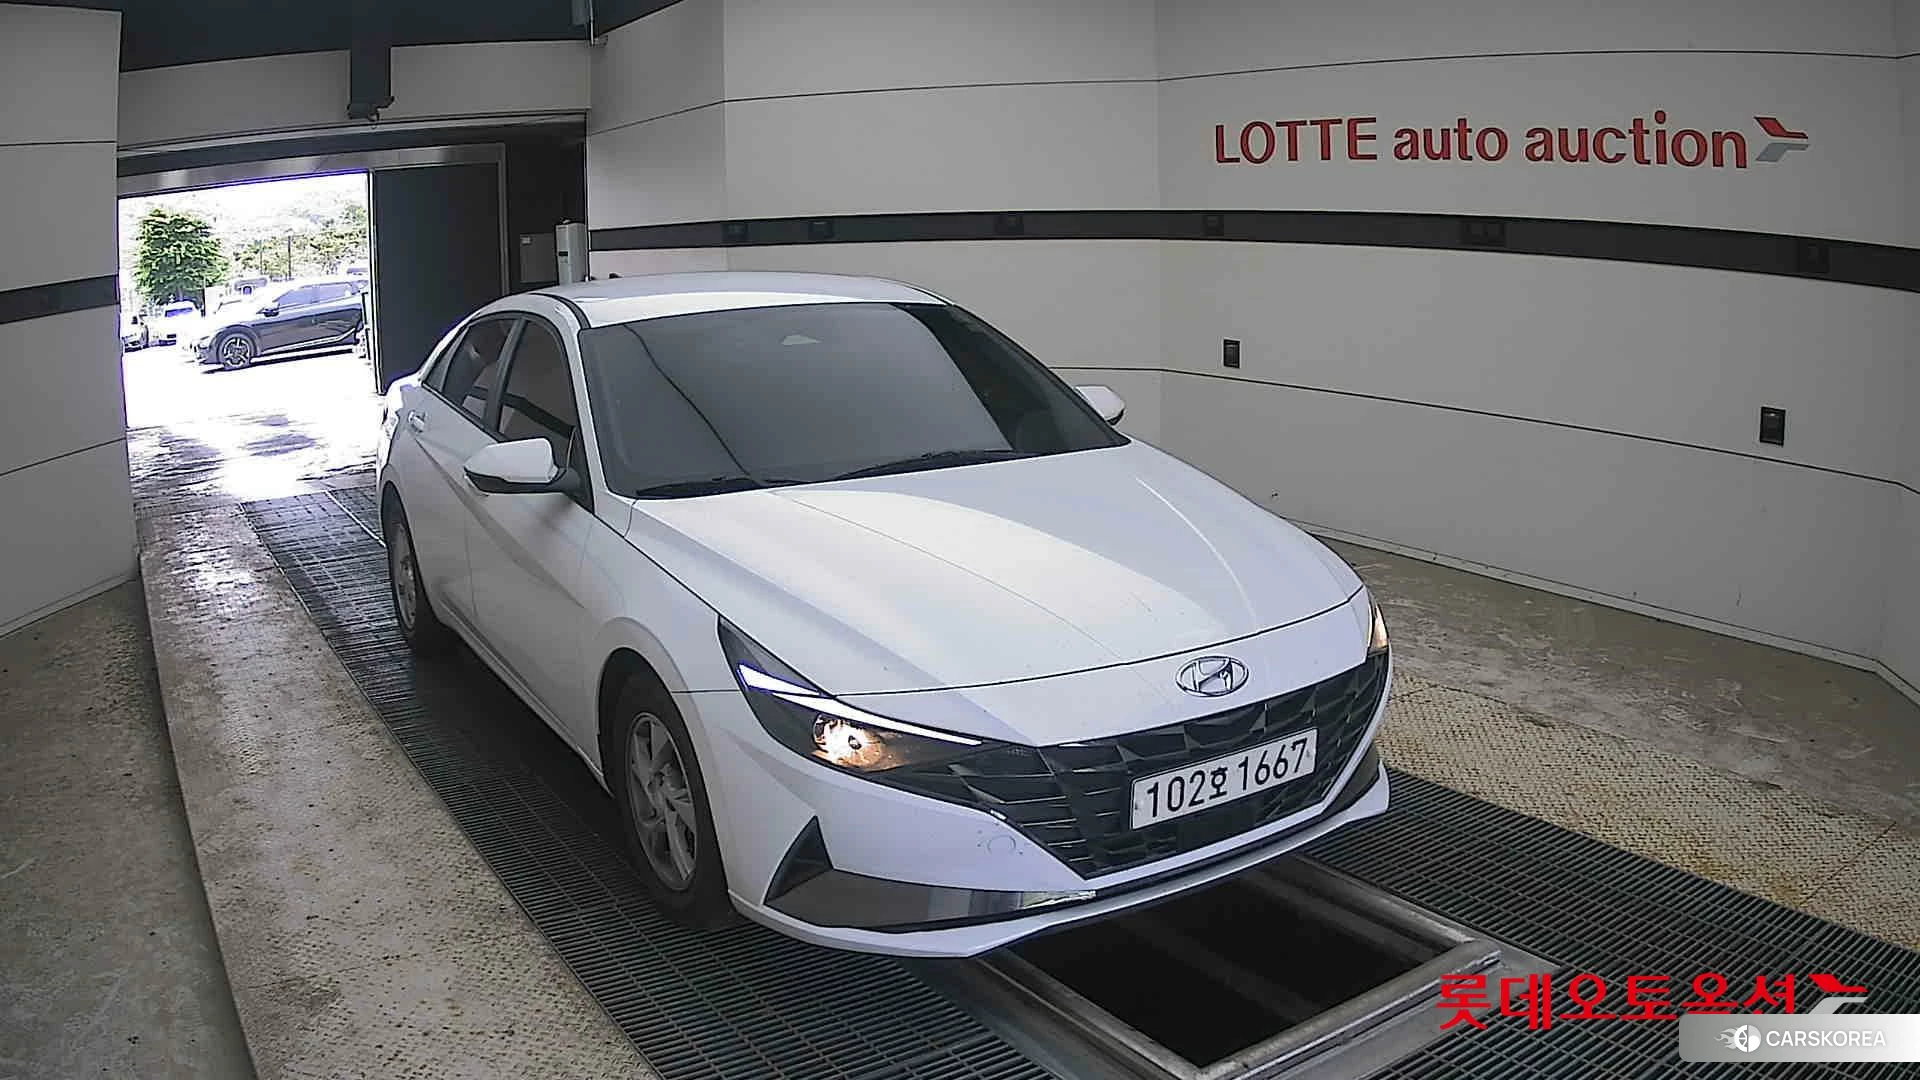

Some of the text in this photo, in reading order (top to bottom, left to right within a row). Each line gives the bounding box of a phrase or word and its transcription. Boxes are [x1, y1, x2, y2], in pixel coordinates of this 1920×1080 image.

[1215, 111, 1748, 169] LOTTE auto auction
[1146, 736, 1309, 818] 102호 1667
